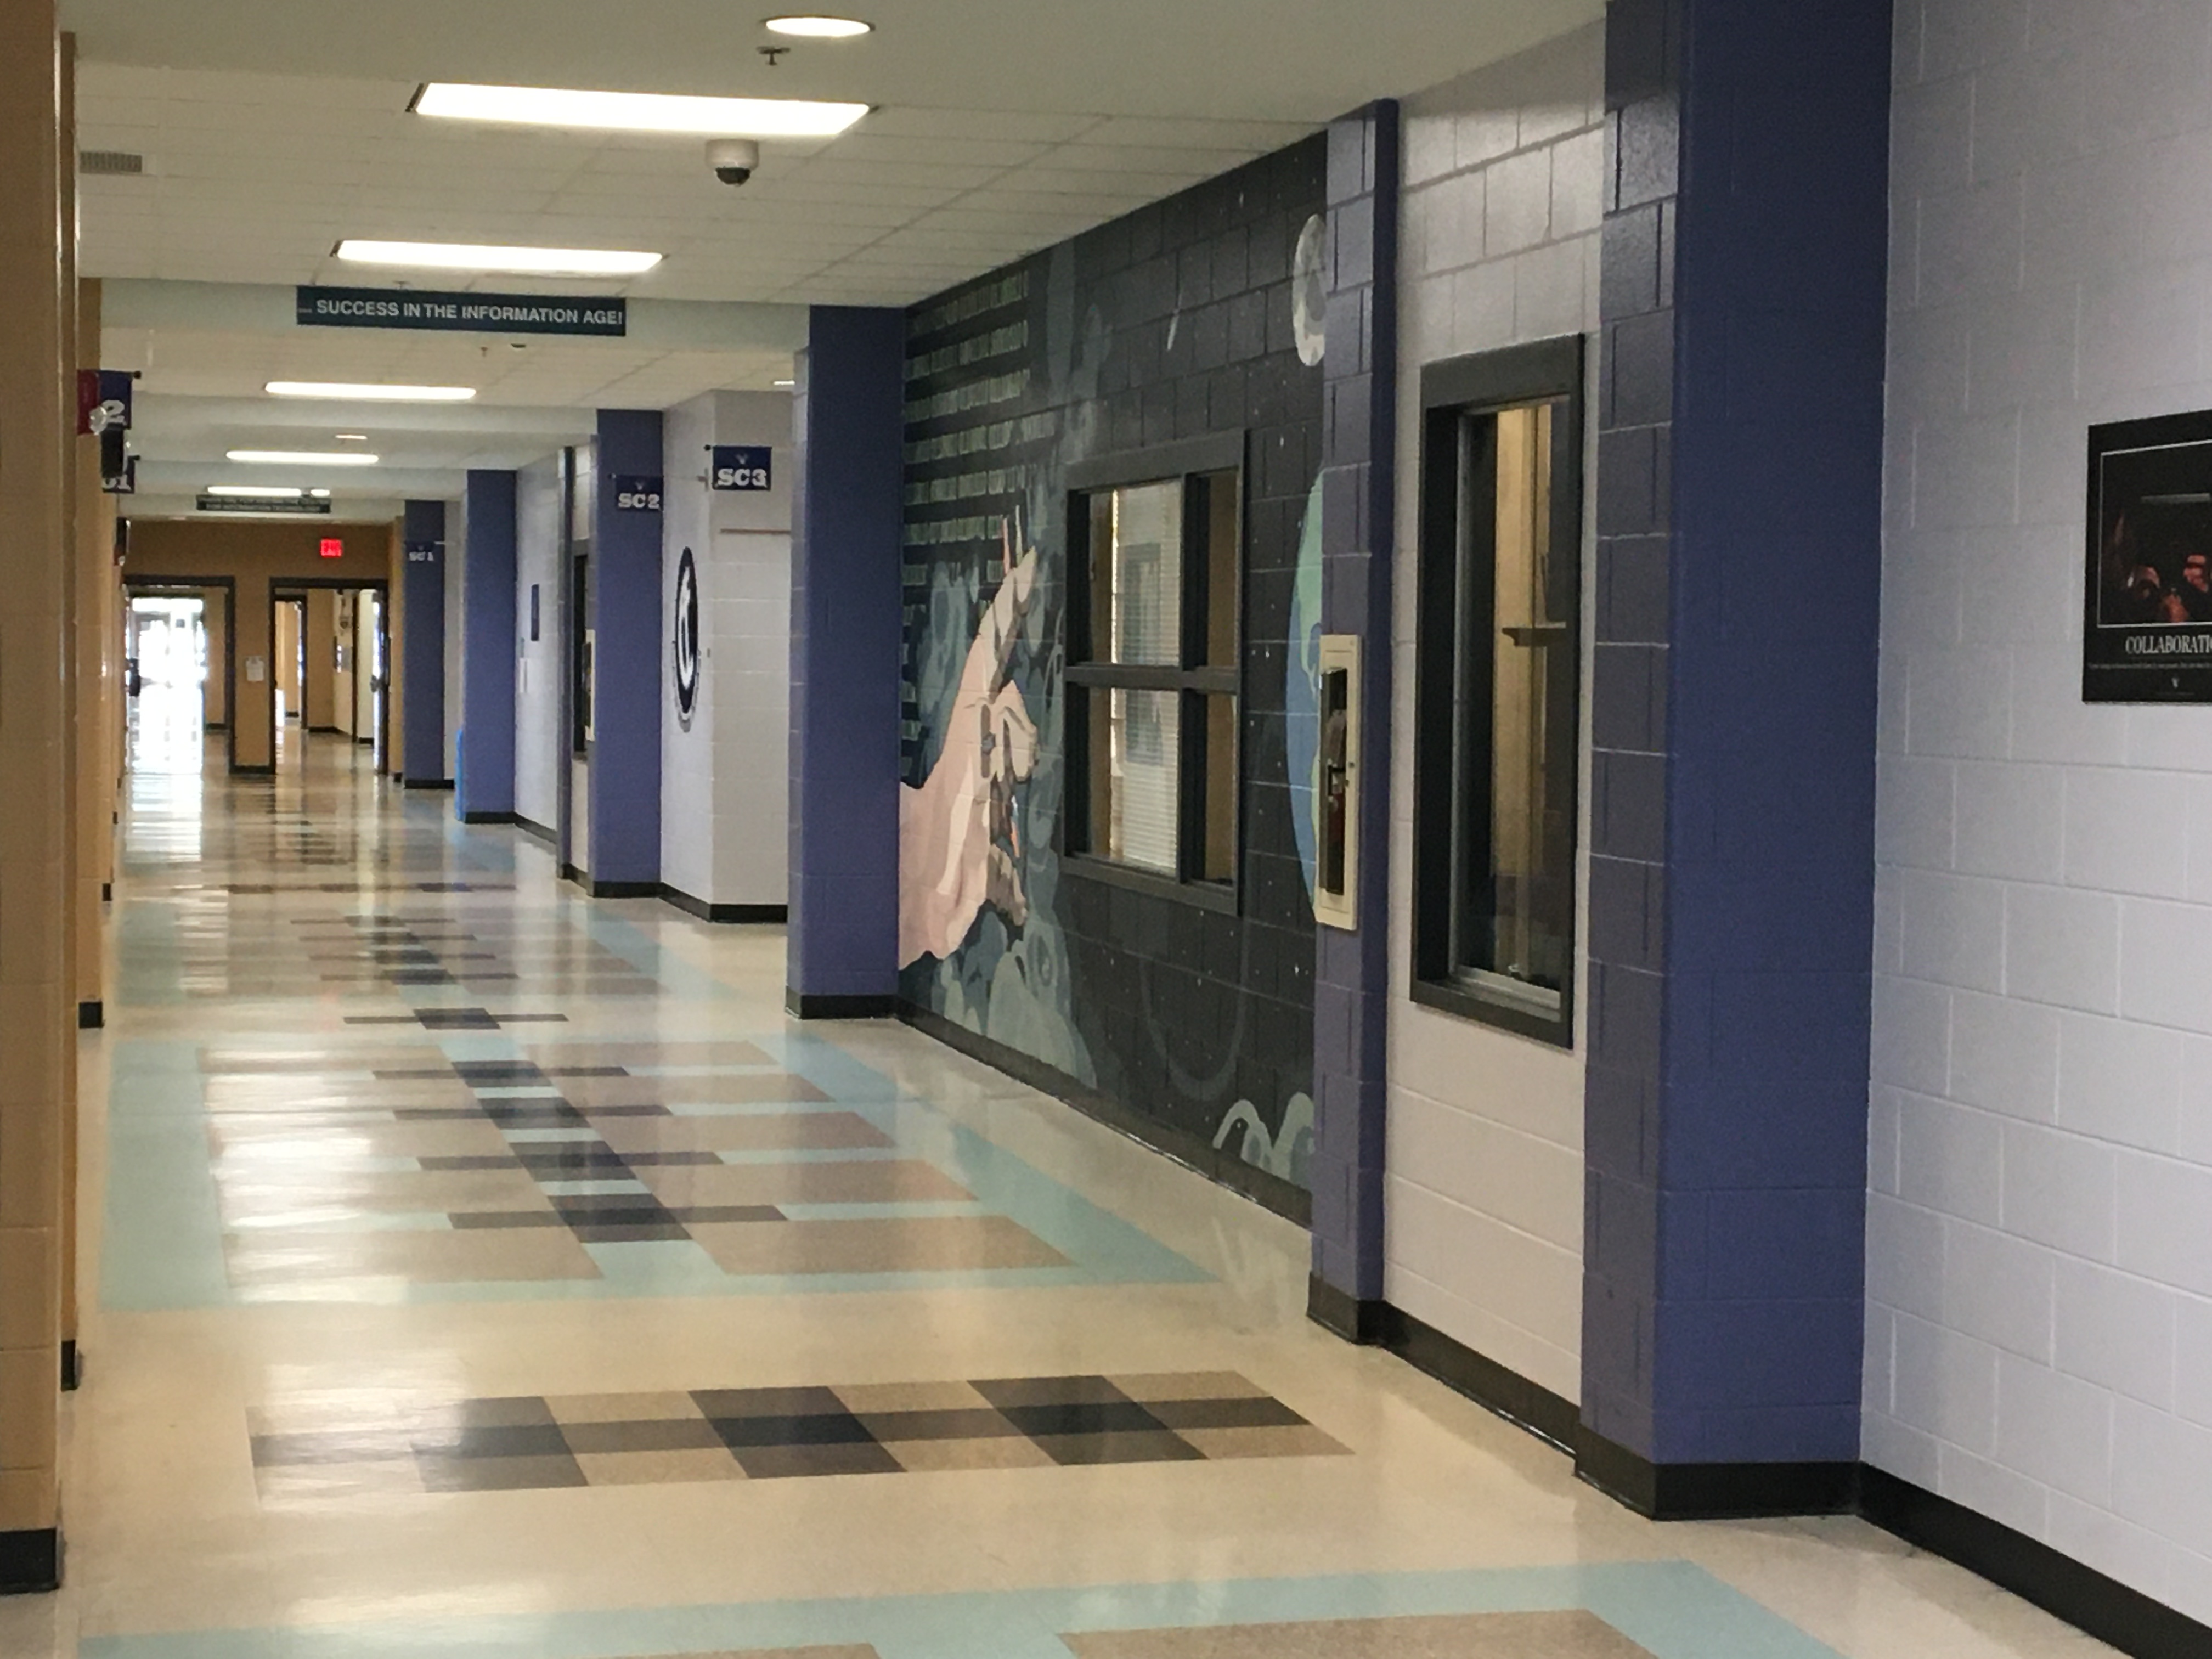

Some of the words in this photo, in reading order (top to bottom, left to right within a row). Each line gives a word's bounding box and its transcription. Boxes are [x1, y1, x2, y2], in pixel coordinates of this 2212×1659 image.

[316, 300, 399, 317] SUCCESS
[403, 303, 421, 317] IN
[424, 303, 457, 318] THE
[462, 305, 578, 323] INFORMATION
[583, 310, 623, 325] AGE!
[717, 468, 768, 487] SC3
[618, 493, 661, 509] SC2
[2125, 634, 2212, 654] COLLABORATI
